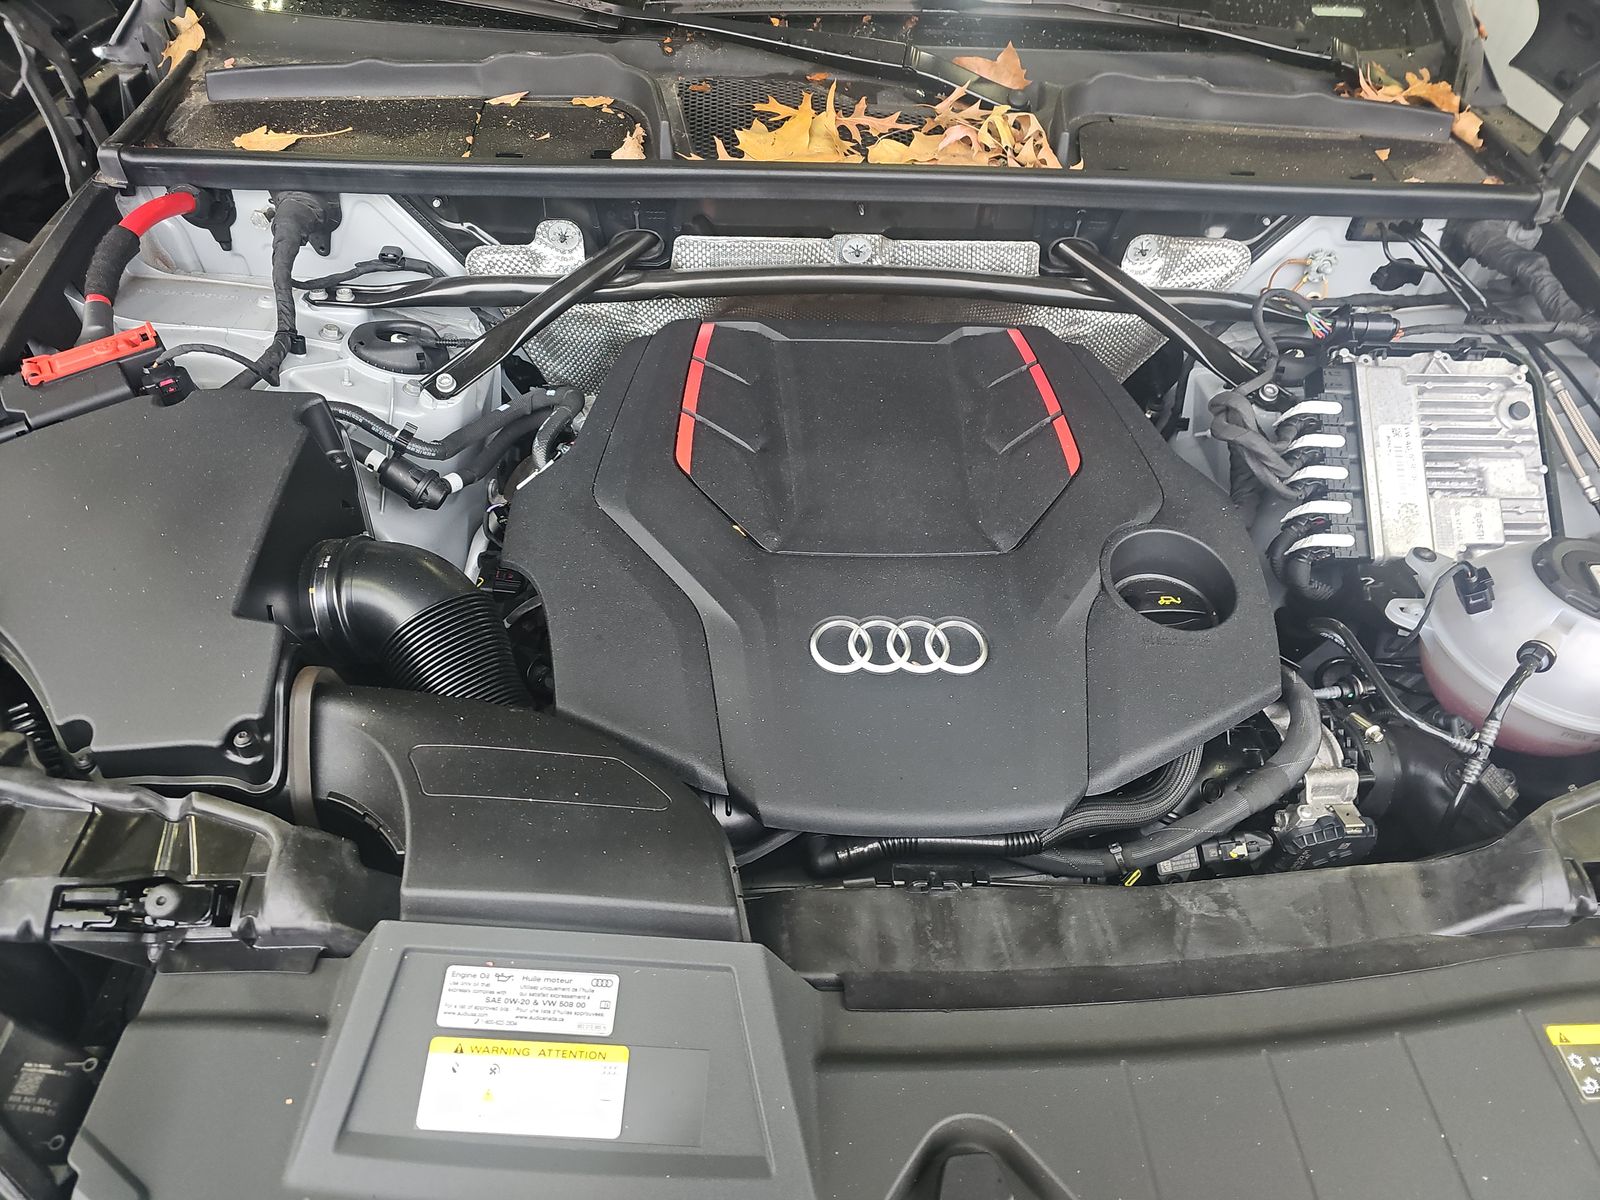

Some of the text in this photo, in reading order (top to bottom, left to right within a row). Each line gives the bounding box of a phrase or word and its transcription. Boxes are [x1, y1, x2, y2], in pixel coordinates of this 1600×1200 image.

[451, 970, 477, 979] Engine
[543, 976, 573, 984] moteur
[504, 997, 531, 1005] 0W-20
[469, 1044, 608, 1061] WARNING ATTENTION
